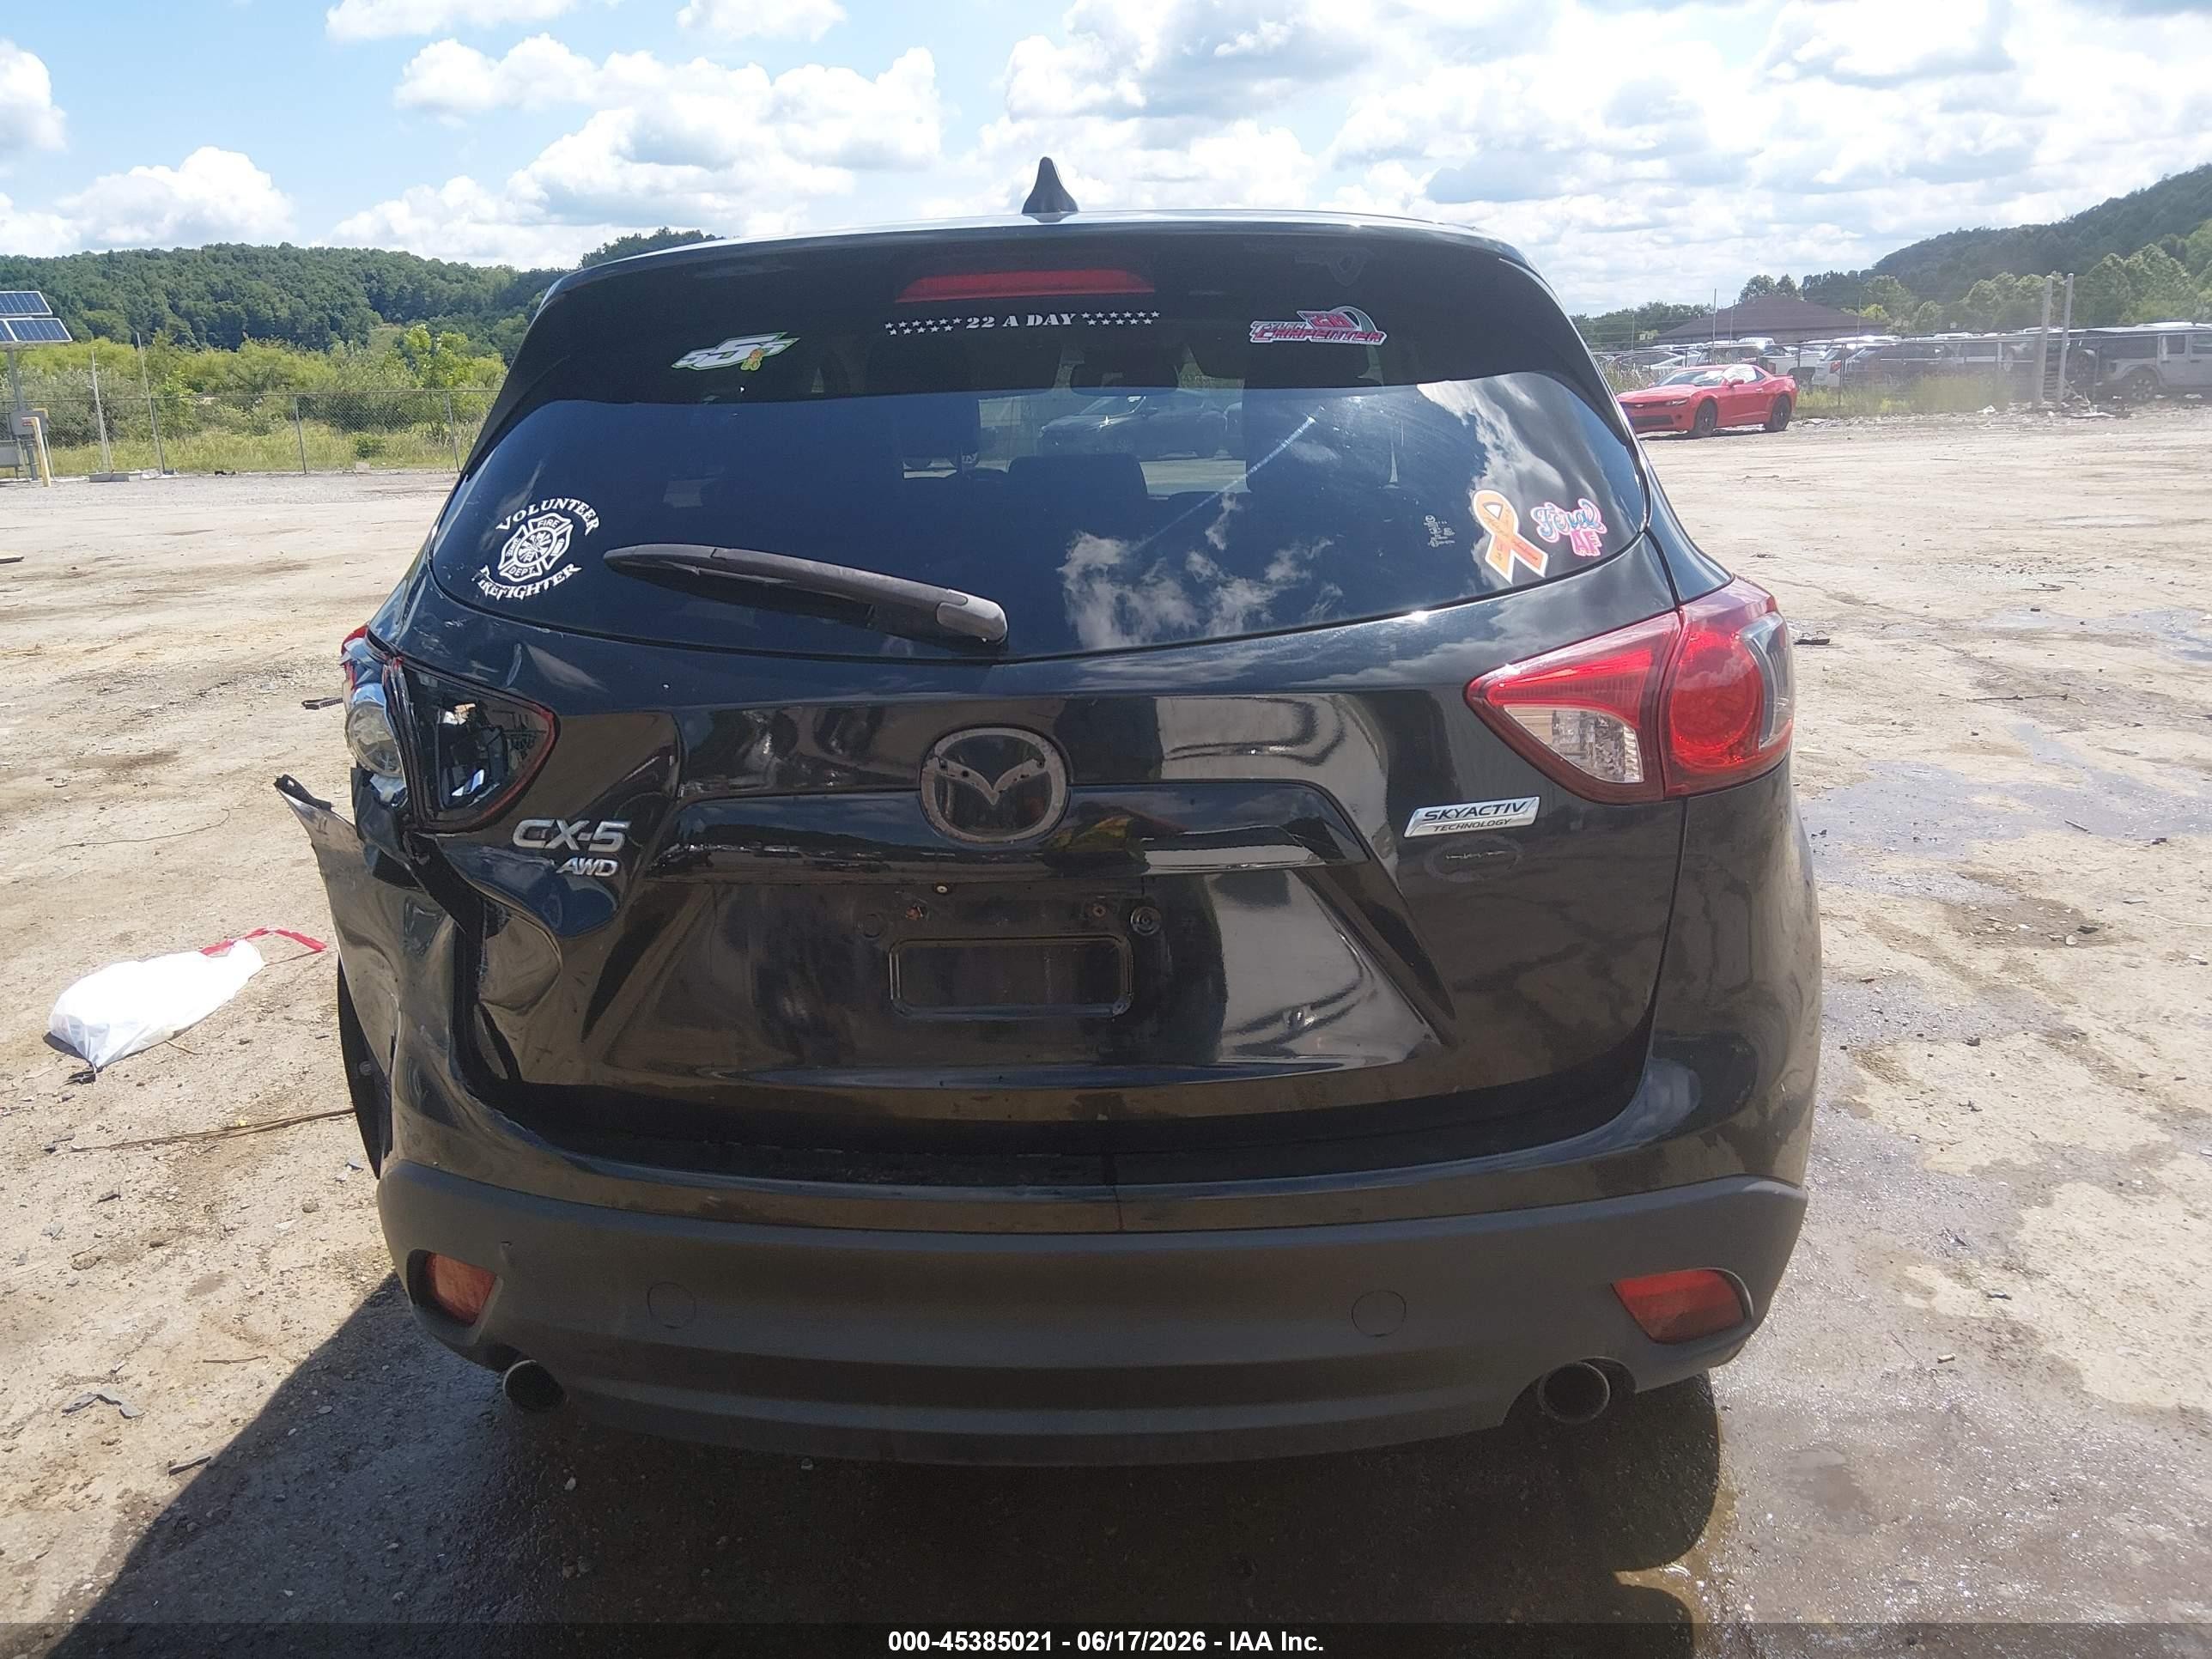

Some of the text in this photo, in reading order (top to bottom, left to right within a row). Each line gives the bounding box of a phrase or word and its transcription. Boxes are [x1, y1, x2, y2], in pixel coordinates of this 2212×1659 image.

[966, 313, 1076, 330] 22 A DAY
[495, 497, 599, 536] VOLUNTEER
[537, 519, 560, 528] FIRE
[1422, 801, 1527, 822] SKYACTIV
[1434, 818, 1511, 832] TECHNOLOGY
[513, 818, 632, 852] CX-5
[556, 858, 618, 877] AWD
